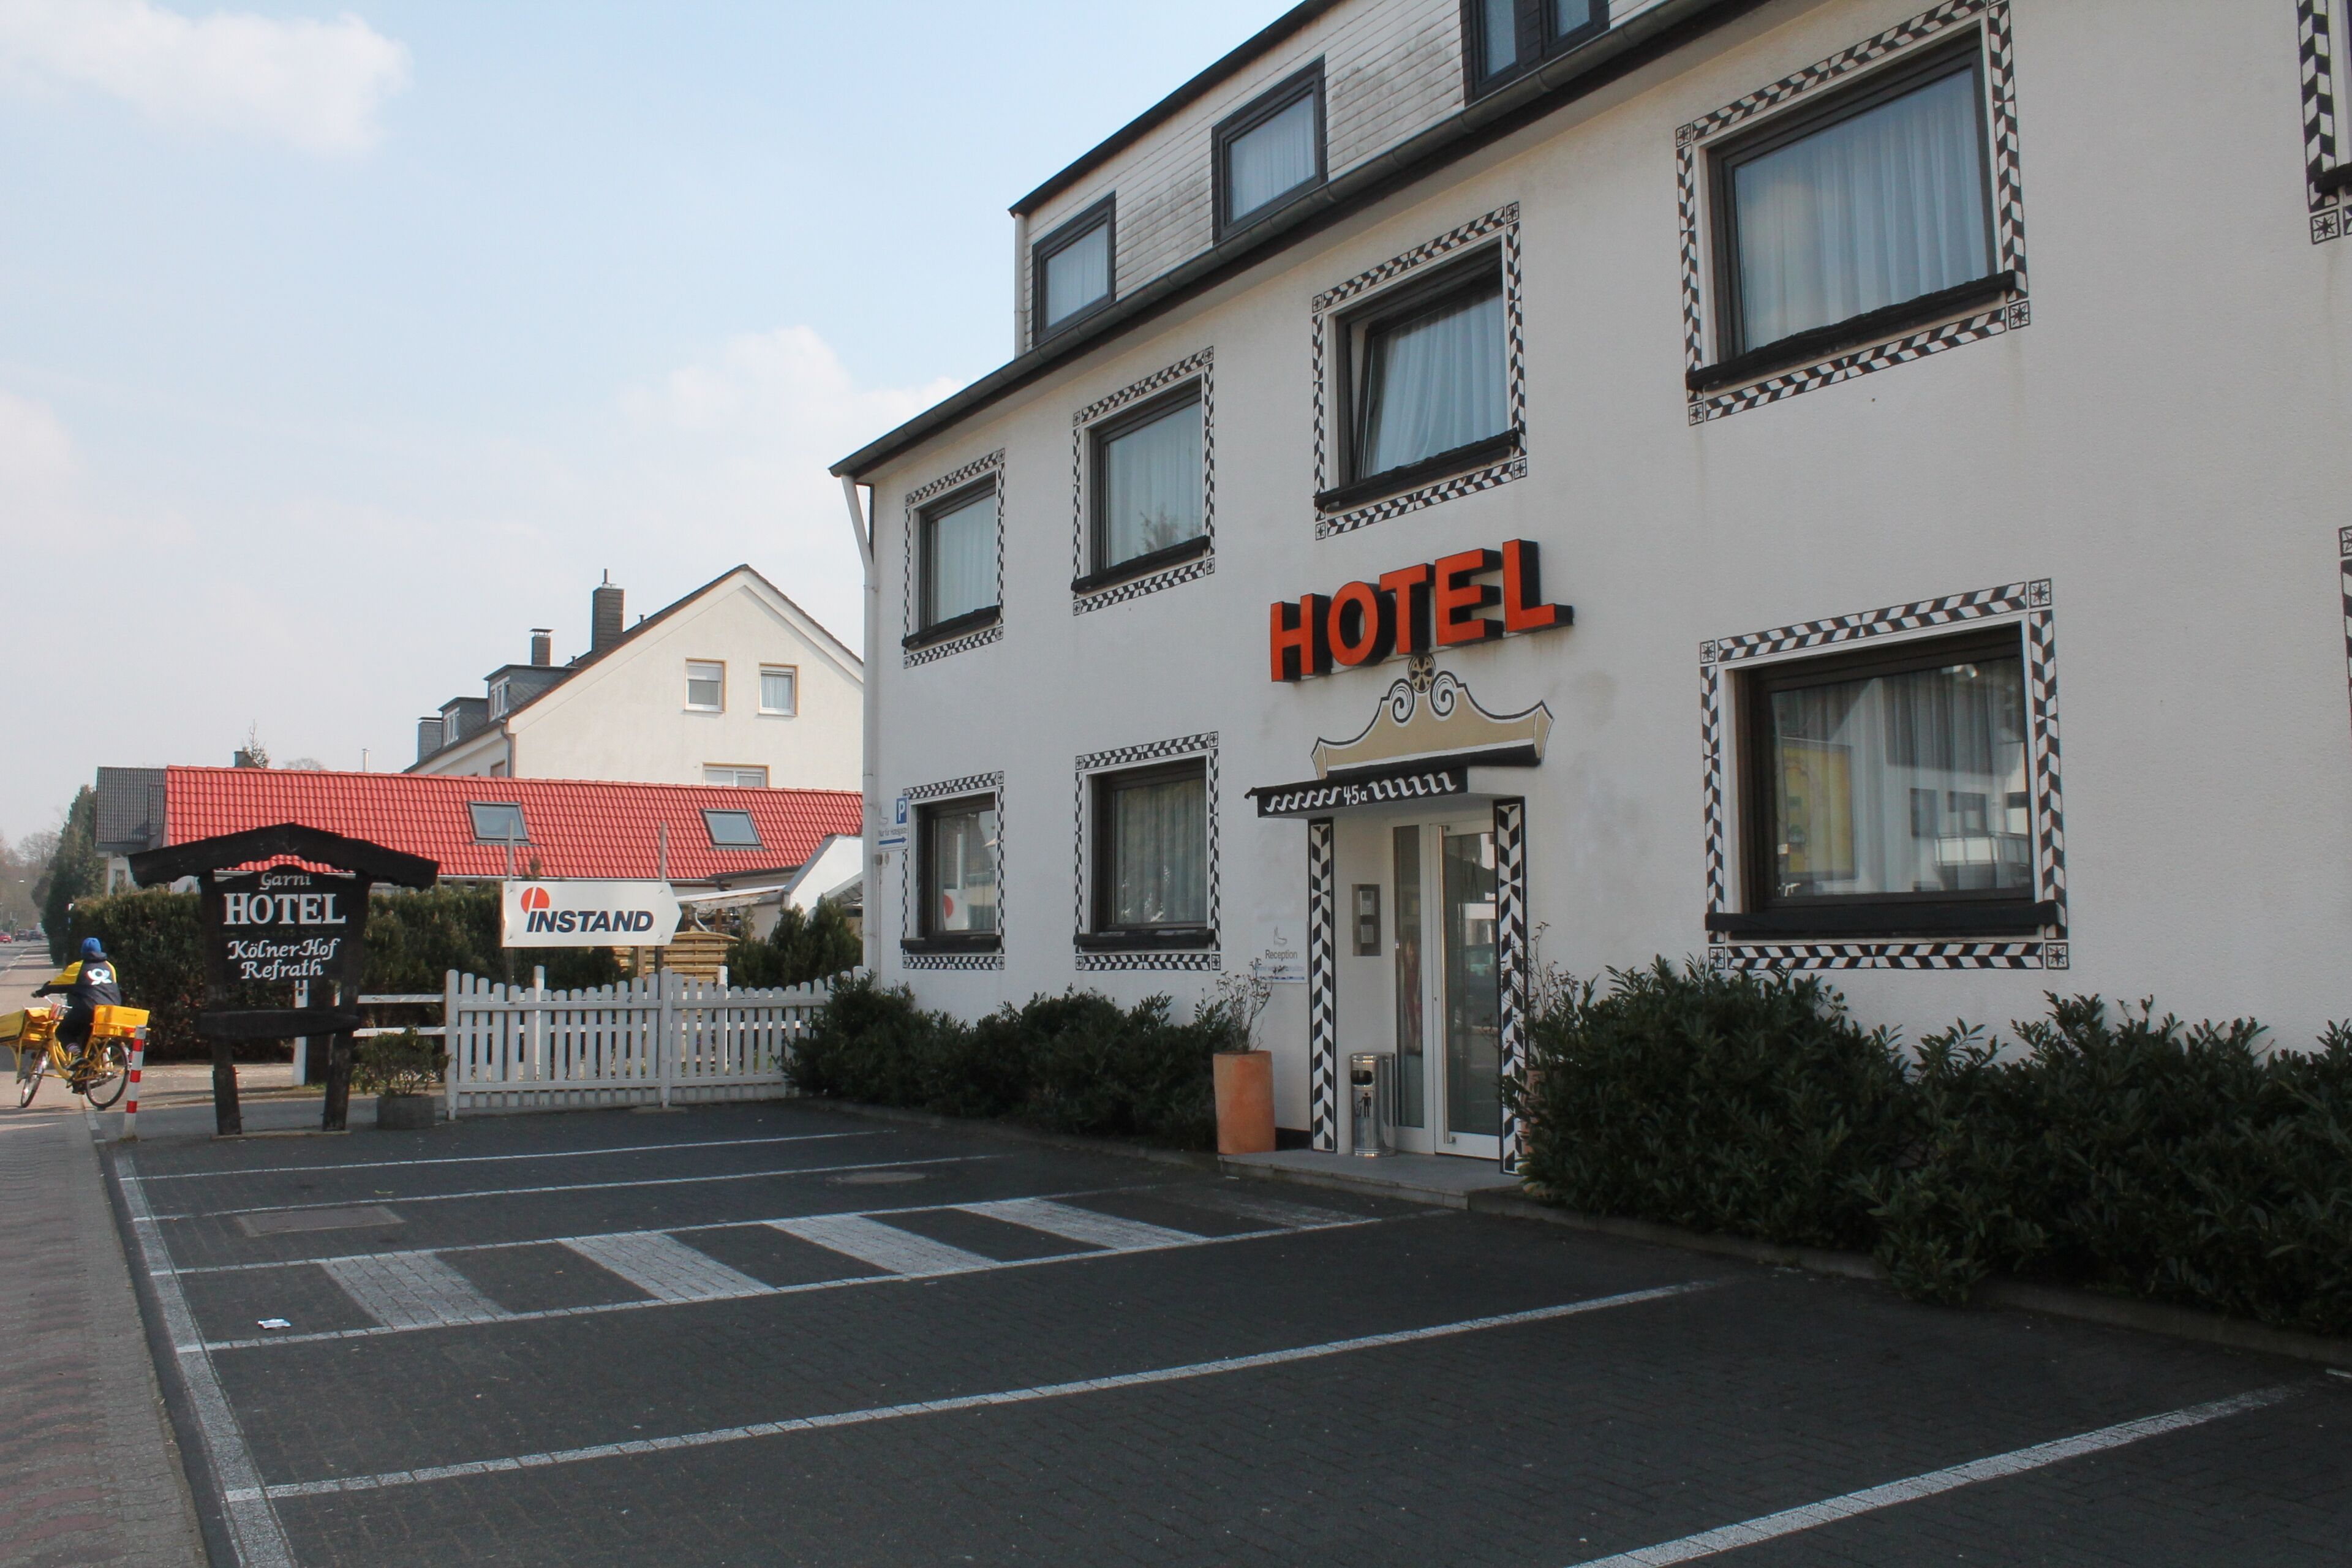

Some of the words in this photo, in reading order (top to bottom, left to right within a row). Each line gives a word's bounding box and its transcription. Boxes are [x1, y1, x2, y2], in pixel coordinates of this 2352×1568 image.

[1270, 538, 1574, 682] HOTEL
[1343, 784, 1368, 805] 45a
[898, 800, 906, 821] P
[259, 872, 312, 890] Garni
[223, 892, 347, 925] HOTEL
[526, 910, 655, 933] INSTAND
[227, 940, 300, 960] Kölner
[298, 938, 341, 961] Hof
[1265, 949, 1298, 961] Reception
[240, 958, 324, 981] Refrath
